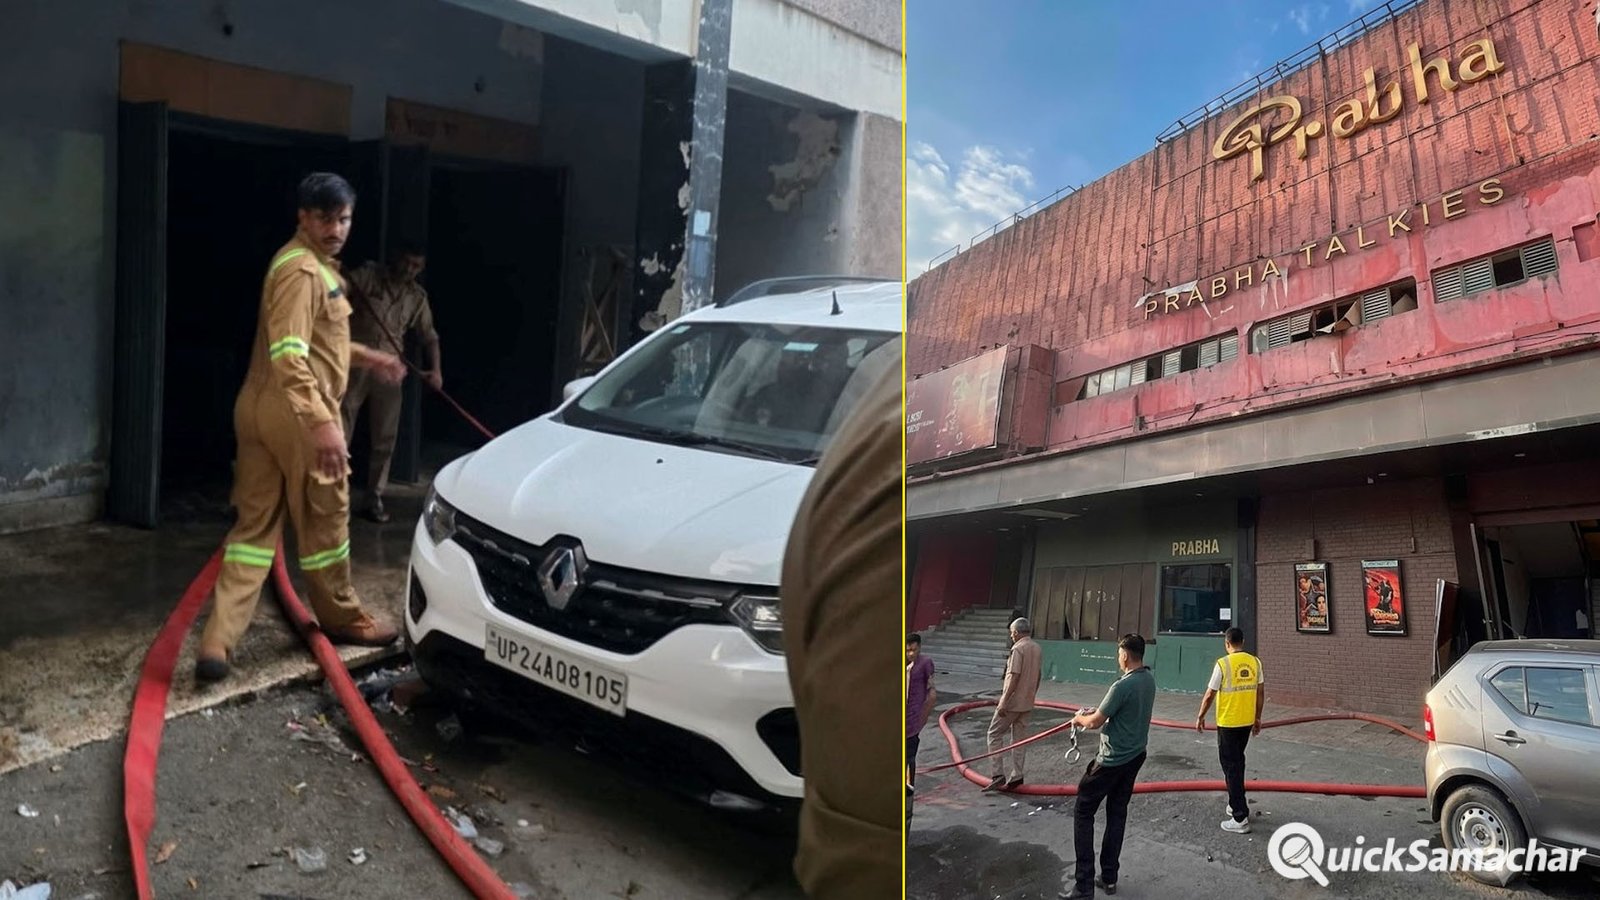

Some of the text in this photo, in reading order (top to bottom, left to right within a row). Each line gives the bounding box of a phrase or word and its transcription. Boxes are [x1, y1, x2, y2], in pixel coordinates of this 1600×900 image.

[1212, 38, 1505, 182] Prabha
[1143, 178, 1505, 320] PRABHA TALKIES
[1171, 540, 1219, 557] PRABHA
